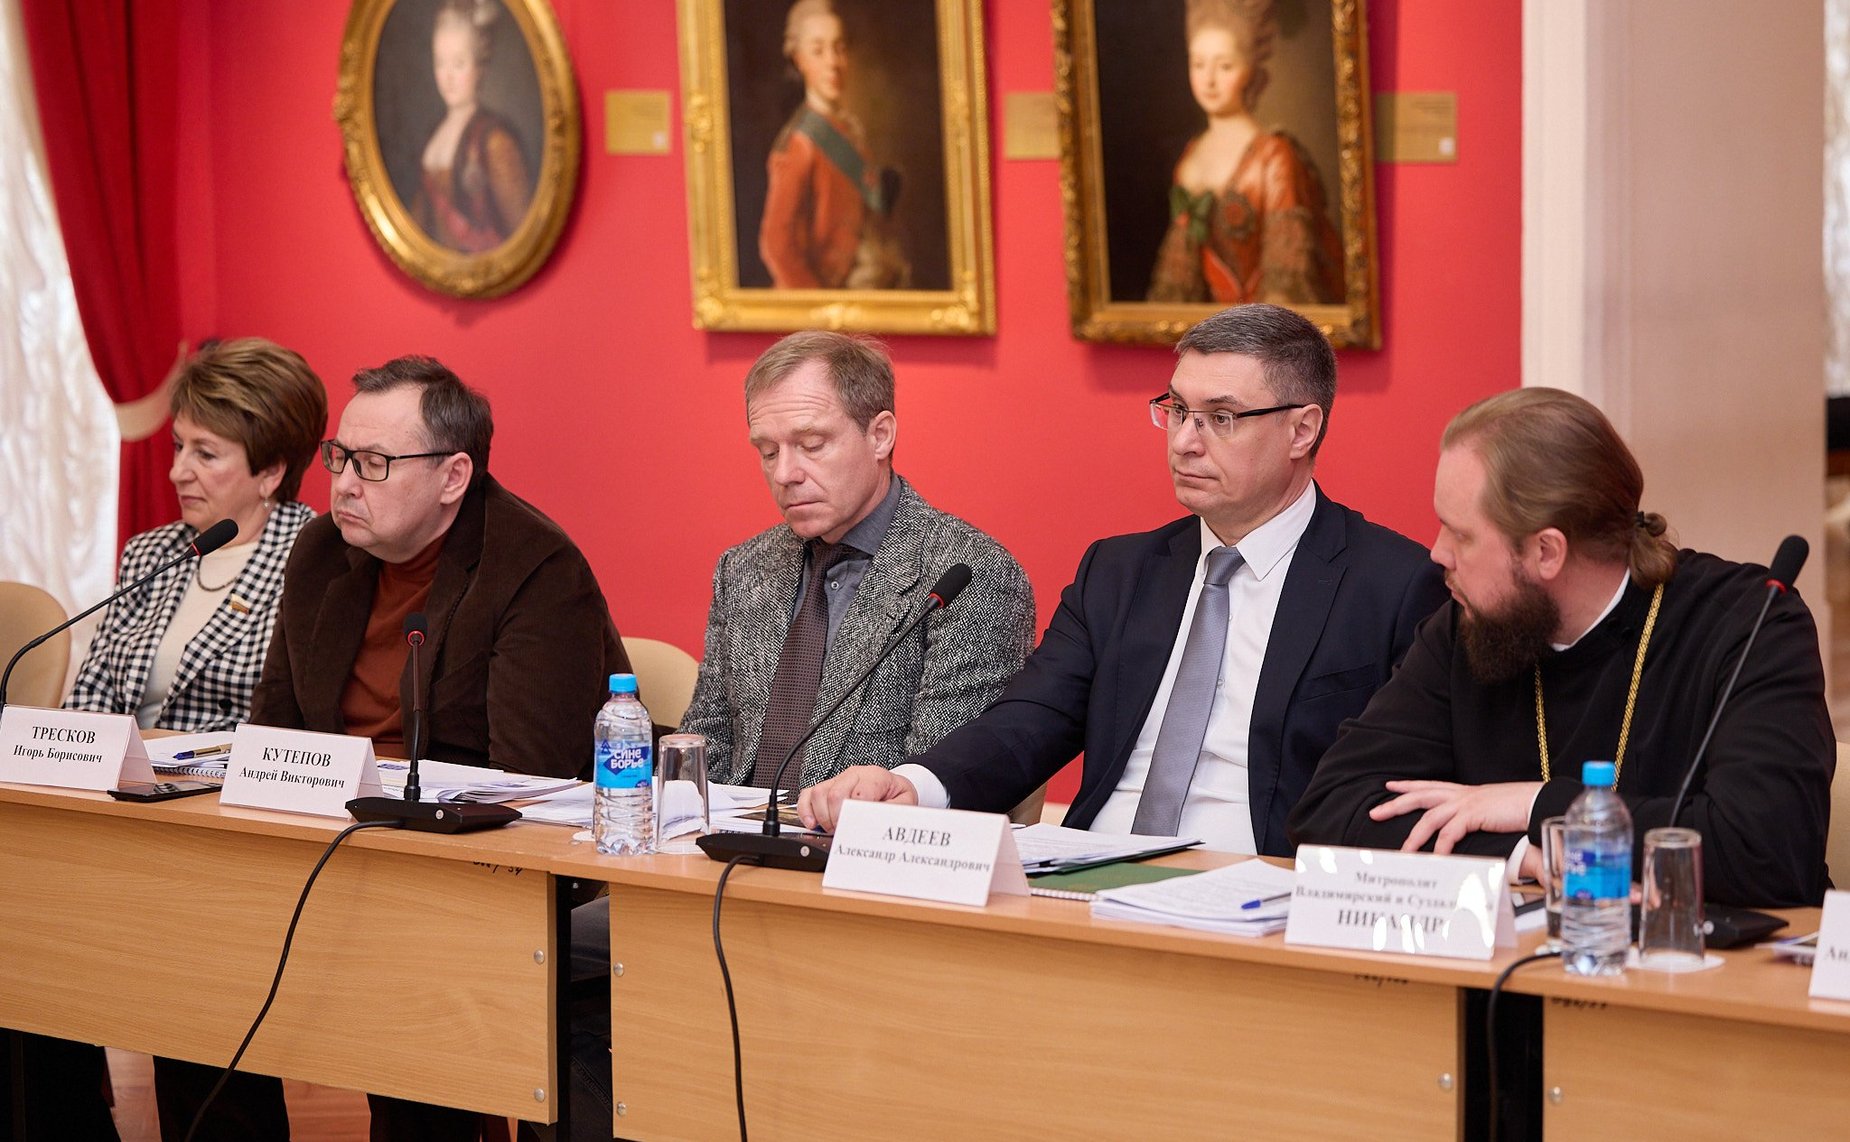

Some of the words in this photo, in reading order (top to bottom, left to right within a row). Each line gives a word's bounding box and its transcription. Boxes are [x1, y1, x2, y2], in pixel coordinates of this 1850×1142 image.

[32, 725, 96, 745] ТРЕСКОВ
[13, 744, 46, 760] Игорь
[47, 746, 103, 763] Борисович
[262, 746, 331, 768] КУТЕПОВ
[239, 766, 278, 782] Андрей
[280, 769, 345, 789] Викторович
[882, 826, 951, 847] АВДЕЕВ
[836, 844, 896, 863] Александр
[898, 852, 990, 872] Александрович
[1355, 871, 1438, 889] Митрополит
